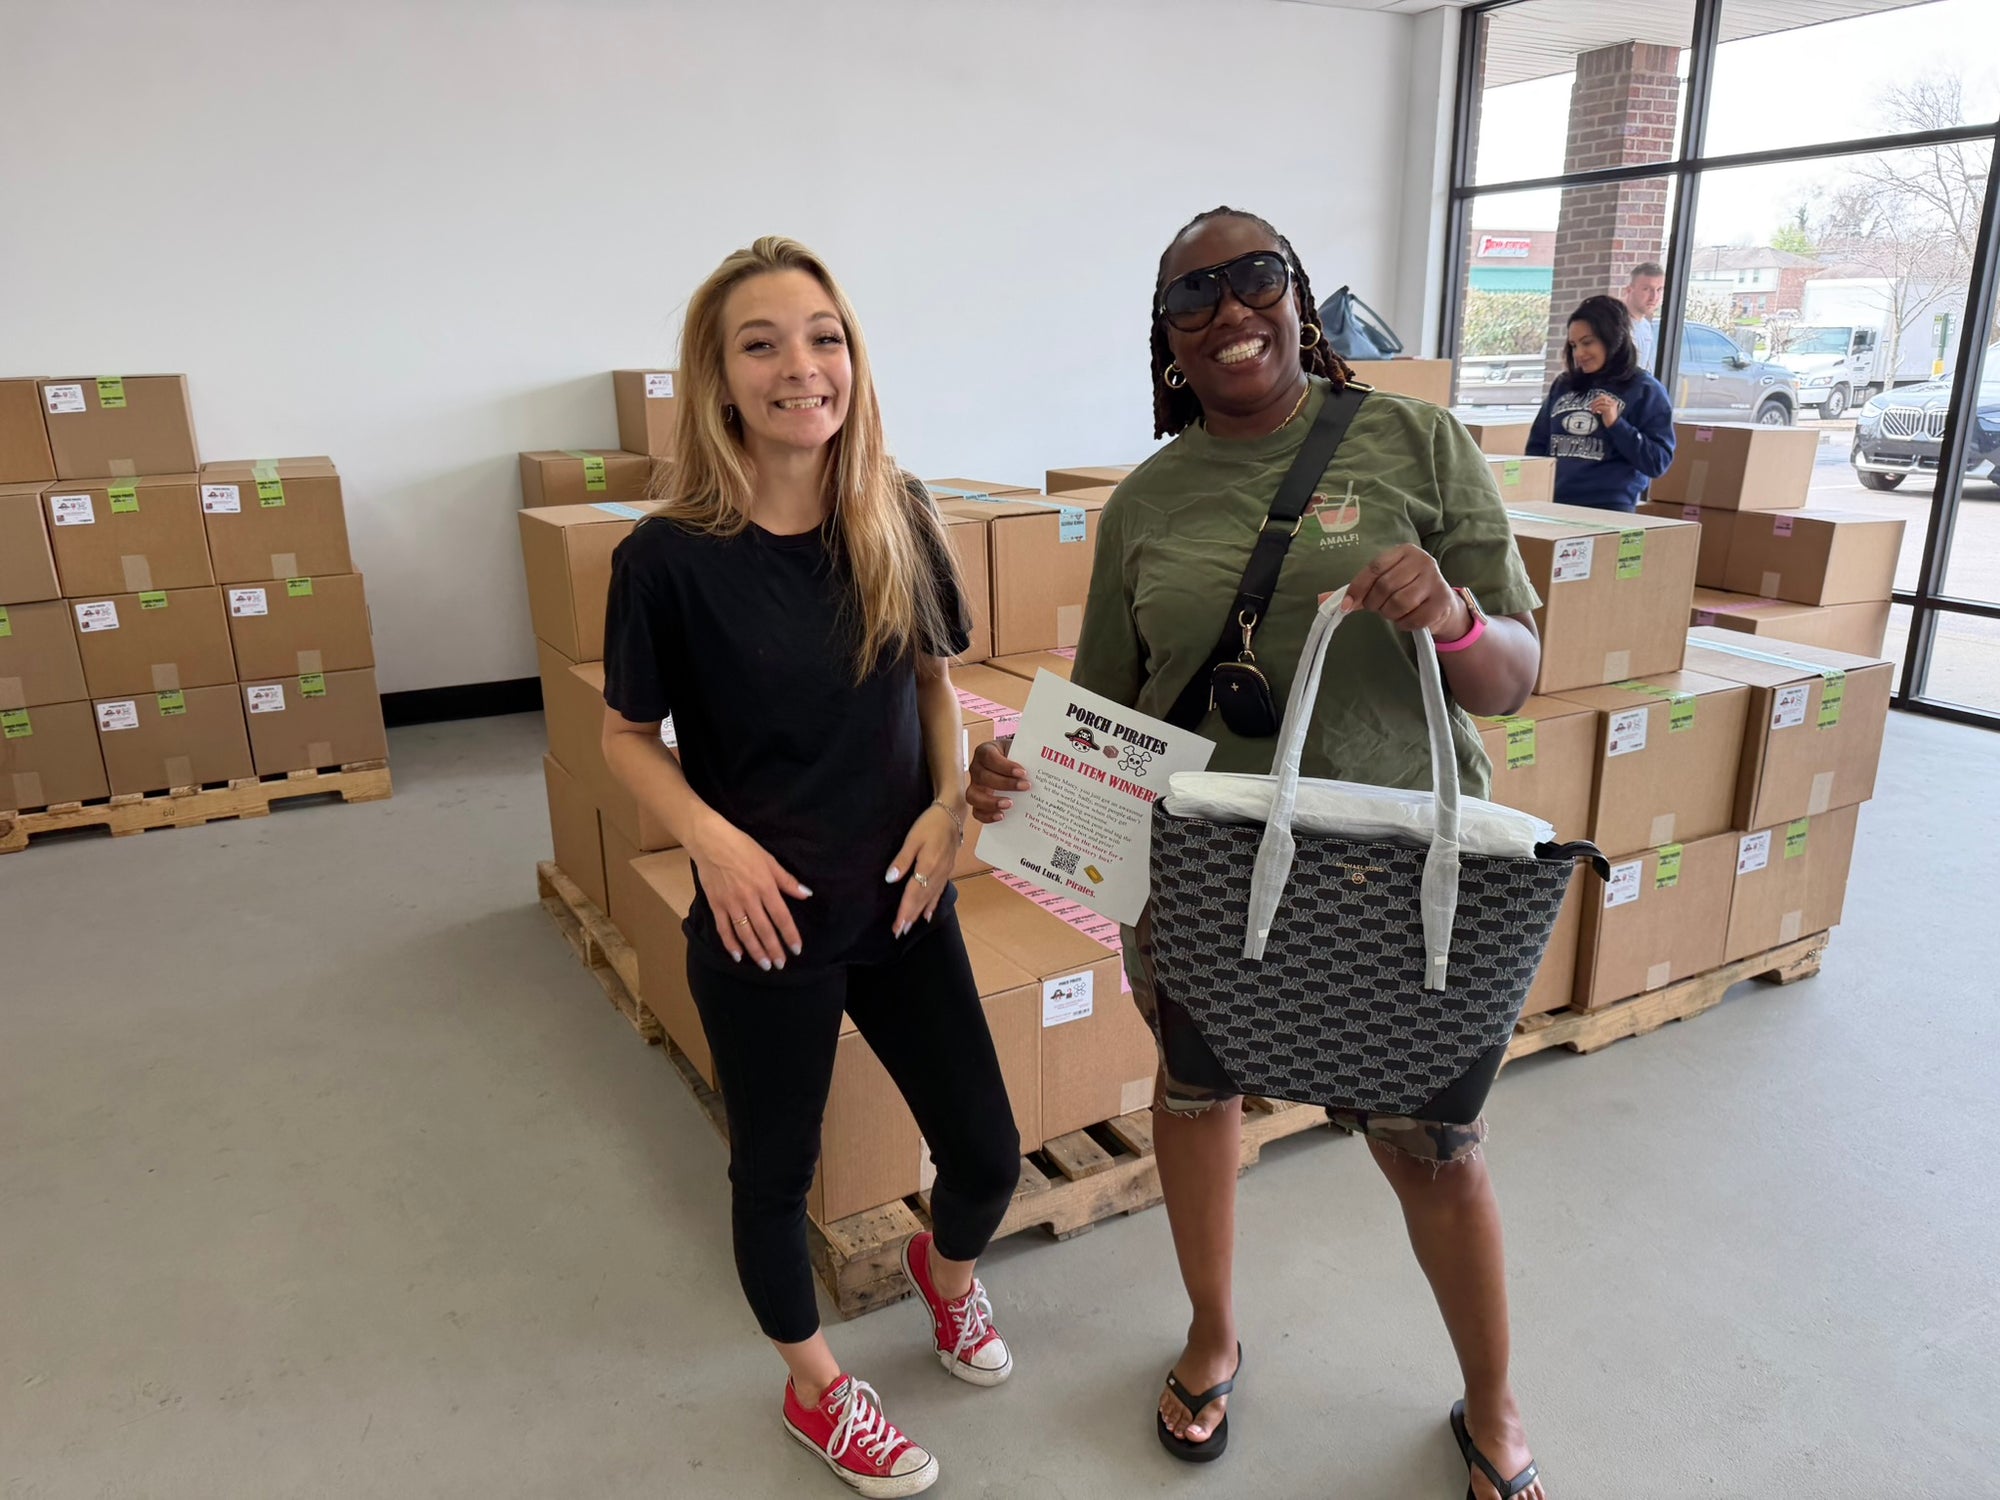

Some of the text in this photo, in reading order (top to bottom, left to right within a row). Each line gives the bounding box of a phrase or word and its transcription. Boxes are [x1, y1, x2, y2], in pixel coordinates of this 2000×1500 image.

[1065, 702, 1168, 757] PORCH PIRATES
[1039, 745, 1158, 804] ULTRA ITEM WINNER!
[1024, 812, 1040, 823] Then
[1057, 827, 1072, 838] back
[1394, 849, 1417, 864] MK
[1298, 860, 1321, 876] MK
[1019, 857, 1041, 873] Good
[1064, 878, 1097, 898] Pirates.
[1205, 873, 1228, 888] MK
[1295, 884, 1318, 899] MK
[1202, 896, 1225, 911] MK
[1317, 899, 1340, 914] MK
[1292, 908, 1315, 923] MK
[1364, 905, 1387, 920] MK
[1338, 914, 1362, 929] MK
[1385, 919, 1408, 935] MK
[1314, 922, 1337, 938] MK
[1360, 928, 1384, 944] MK
[1220, 933, 1243, 949] MK
[1289, 931, 1312, 946] MK
[1335, 937, 1358, 952] MK
[1310, 945, 1334, 961] MK
[1381, 942, 1405, 958] MK
[1216, 956, 1240, 971] MK
[1286, 954, 1309, 969] MK
[1356, 951, 1380, 967] MK
[1261, 962, 1285, 977] MK
[1332, 960, 1355, 975] MK
[1378, 966, 1401, 981] MK
[1237, 970, 1260, 985] MK
[1307, 968, 1330, 983] MK
[1353, 974, 1376, 990] MK
[1213, 978, 1236, 993] MK
[1282, 976, 1305, 991] MK
[1328, 982, 1351, 998] MK
[1399, 980, 1422, 995] MK
[1258, 984, 1281, 999] MK
[1303, 990, 1326, 1006] MK
[1374, 988, 1397, 1004] MK
[1234, 992, 1257, 1007] MK
[1278, 998, 1302, 1013] MK
[1349, 996, 1372, 1012] MK
[1420, 994, 1443, 1009] MK
[1210, 1000, 1233, 1015] MK
[1254, 1006, 1278, 1021] MK
[1324, 1004, 1347, 1020] MK
[1395, 1002, 1418, 1018] MK
[1230, 1014, 1254, 1029] MK
[1300, 1012, 1323, 1028] MK
[1370, 1010, 1393, 1026] MK
[1441, 1008, 1465, 1023] MK
[1206, 1022, 1230, 1037] MK
[1275, 1020, 1298, 1035] MK
[1345, 1019, 1369, 1034] MK
[1416, 1016, 1439, 1032] MK
[1251, 1028, 1274, 1043] MK
[1320, 1026, 1344, 1042] MK
[1391, 1025, 1414, 1040] MK
[1437, 1030, 1460, 1046] MK
[1227, 1036, 1250, 1051] MK
[1296, 1034, 1319, 1050] MK
[1342, 1040, 1365, 1056] MK
[1366, 1033, 1389, 1048] MK
[1412, 1039, 1435, 1054] MK
[1272, 1042, 1295, 1057] MK
[1317, 1048, 1340, 1064] MK
[1387, 1047, 1411, 1062] MK
[1248, 1050, 1271, 1065] MK
[1293, 1056, 1316, 1071] MK
[1362, 1054, 1386, 1070] MK
[1433, 1052, 1456, 1068] MK
[1268, 1064, 1292, 1079] MK
[1338, 1062, 1361, 1078] MK
[1408, 1060, 1431, 1076] MK
[1313, 1070, 1337, 1085] MK
[1358, 1076, 1382, 1091] MK
[1383, 1068, 1407, 1084] MK
[1404, 1082, 1427, 1098] MK
